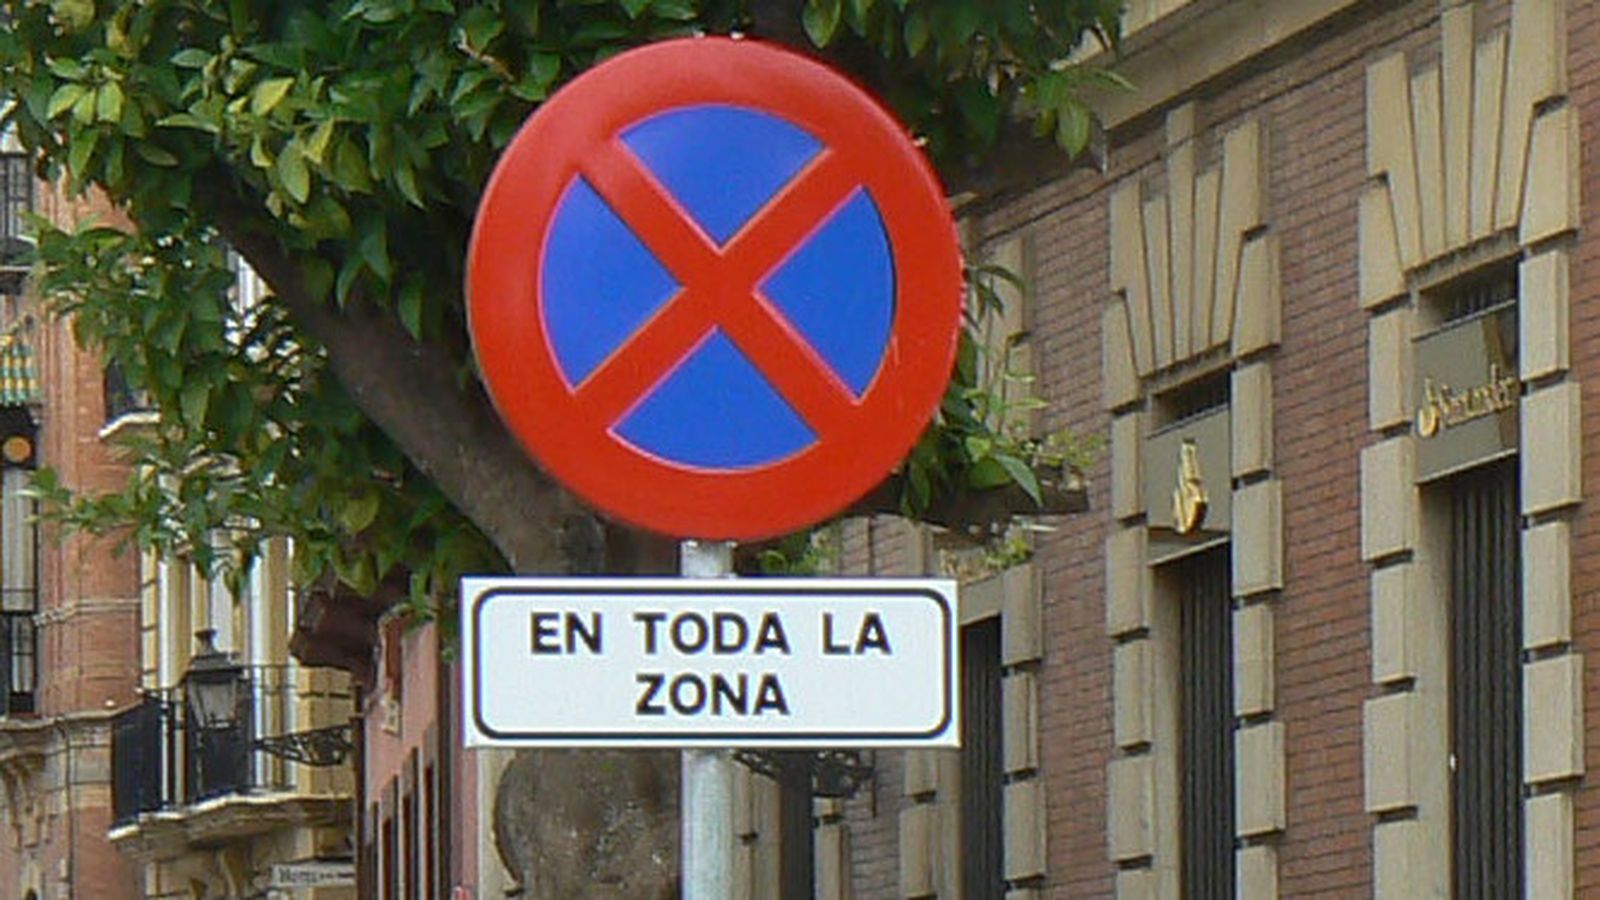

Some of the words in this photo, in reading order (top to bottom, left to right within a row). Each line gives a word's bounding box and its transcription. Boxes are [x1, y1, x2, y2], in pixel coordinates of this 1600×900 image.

[531, 612, 603, 655] EN
[634, 612, 791, 655] TODA
[823, 613, 892, 655] LA
[636, 673, 790, 716] ZONA
